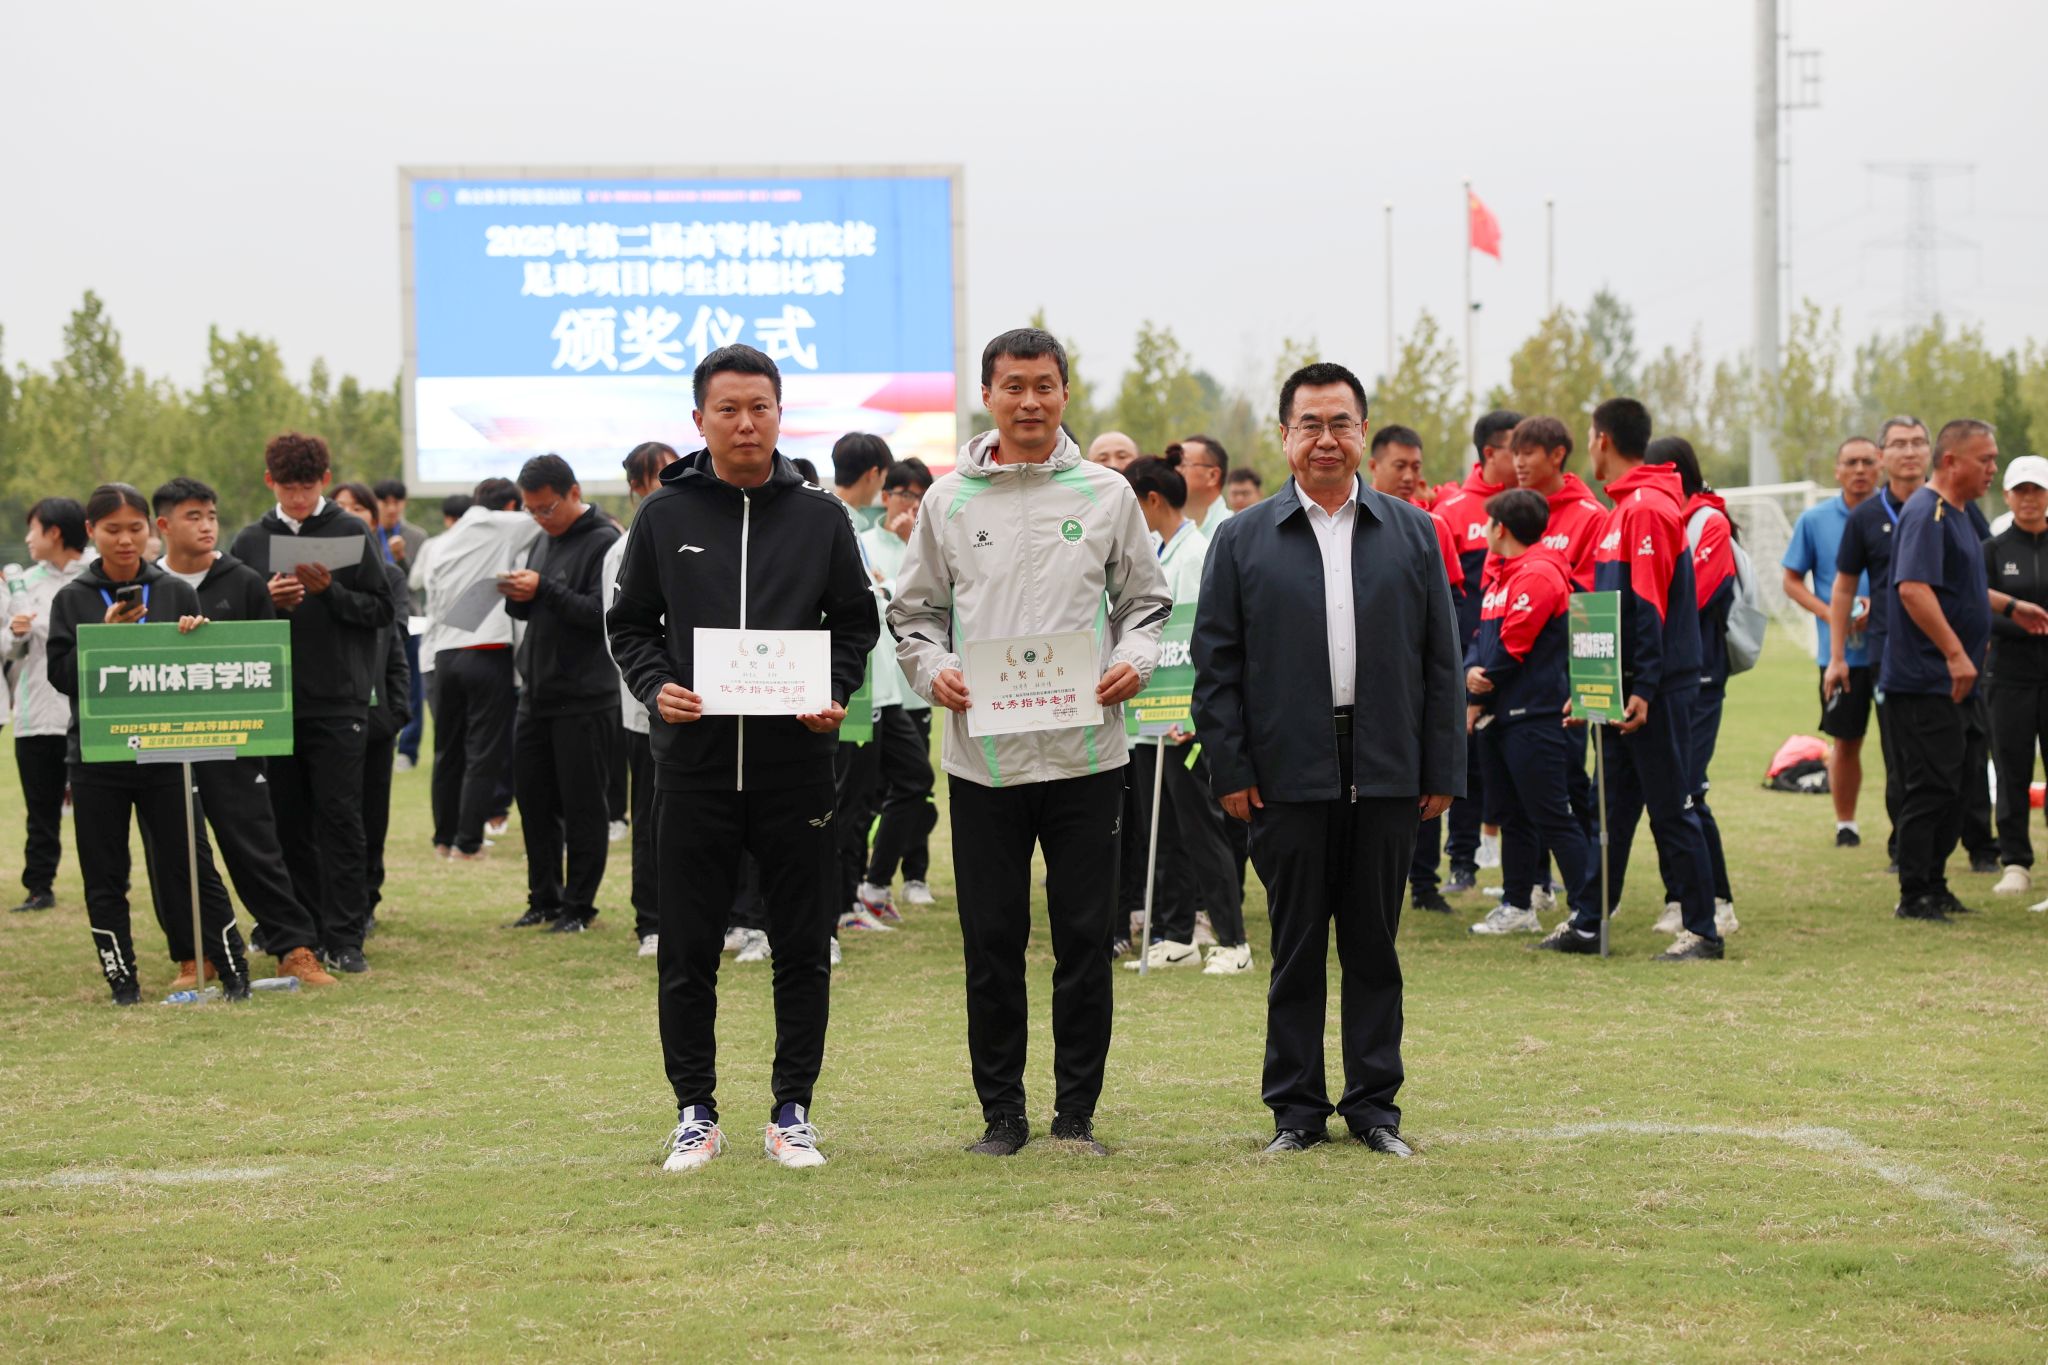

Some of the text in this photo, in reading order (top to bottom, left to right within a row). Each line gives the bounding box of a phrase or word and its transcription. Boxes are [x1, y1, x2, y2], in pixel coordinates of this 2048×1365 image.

[551, 304, 819, 372] 颁奖仪式
[99, 661, 272, 693] 广州体育学院
[992, 694, 1076, 710] 优秀指导老师
